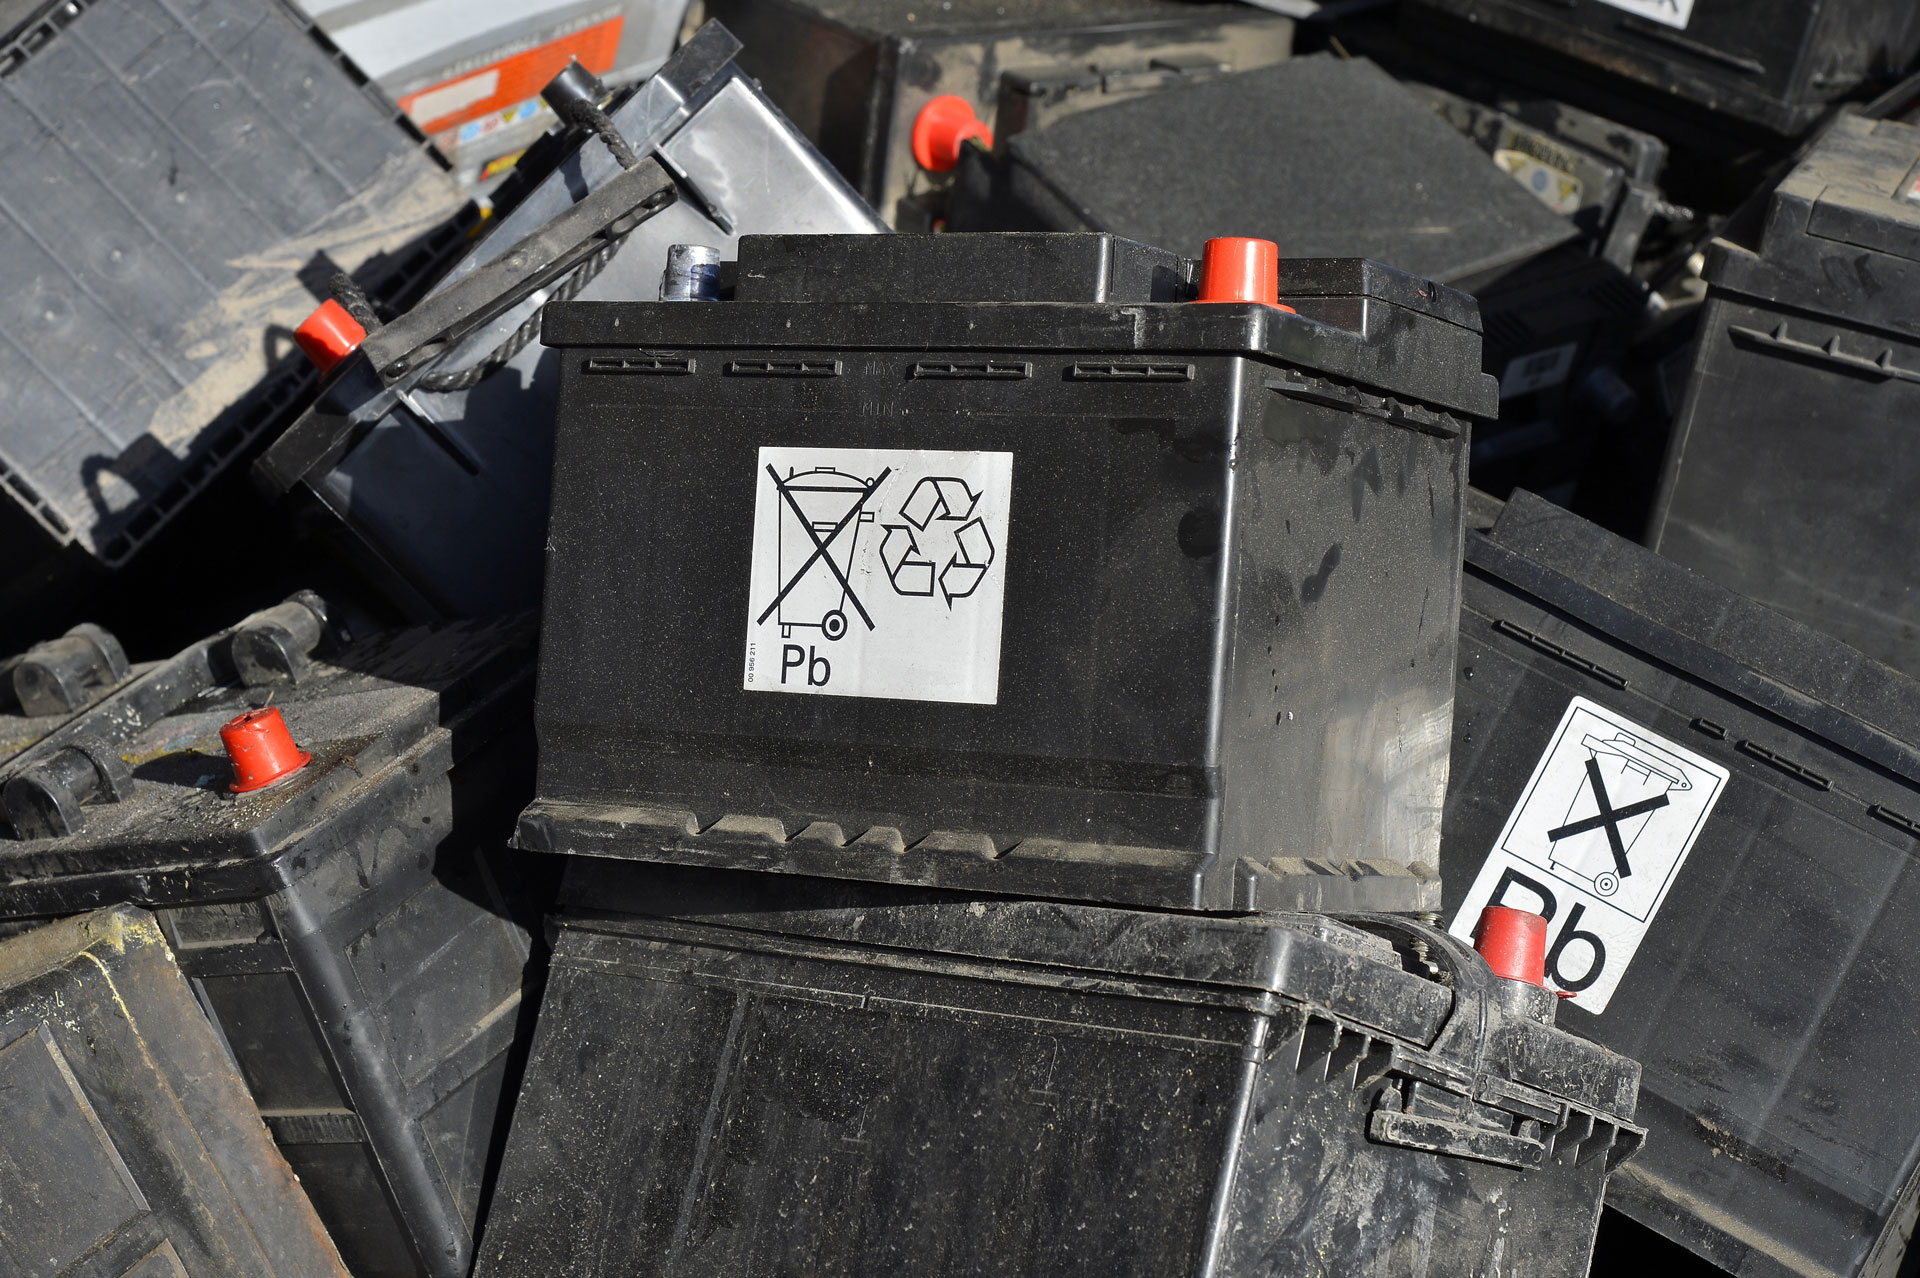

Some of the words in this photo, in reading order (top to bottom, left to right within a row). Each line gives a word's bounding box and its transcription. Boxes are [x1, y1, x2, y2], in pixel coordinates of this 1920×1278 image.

[864, 360, 895, 375] MAX
[862, 401, 894, 416] MIN
[781, 644, 831, 687] Pb
